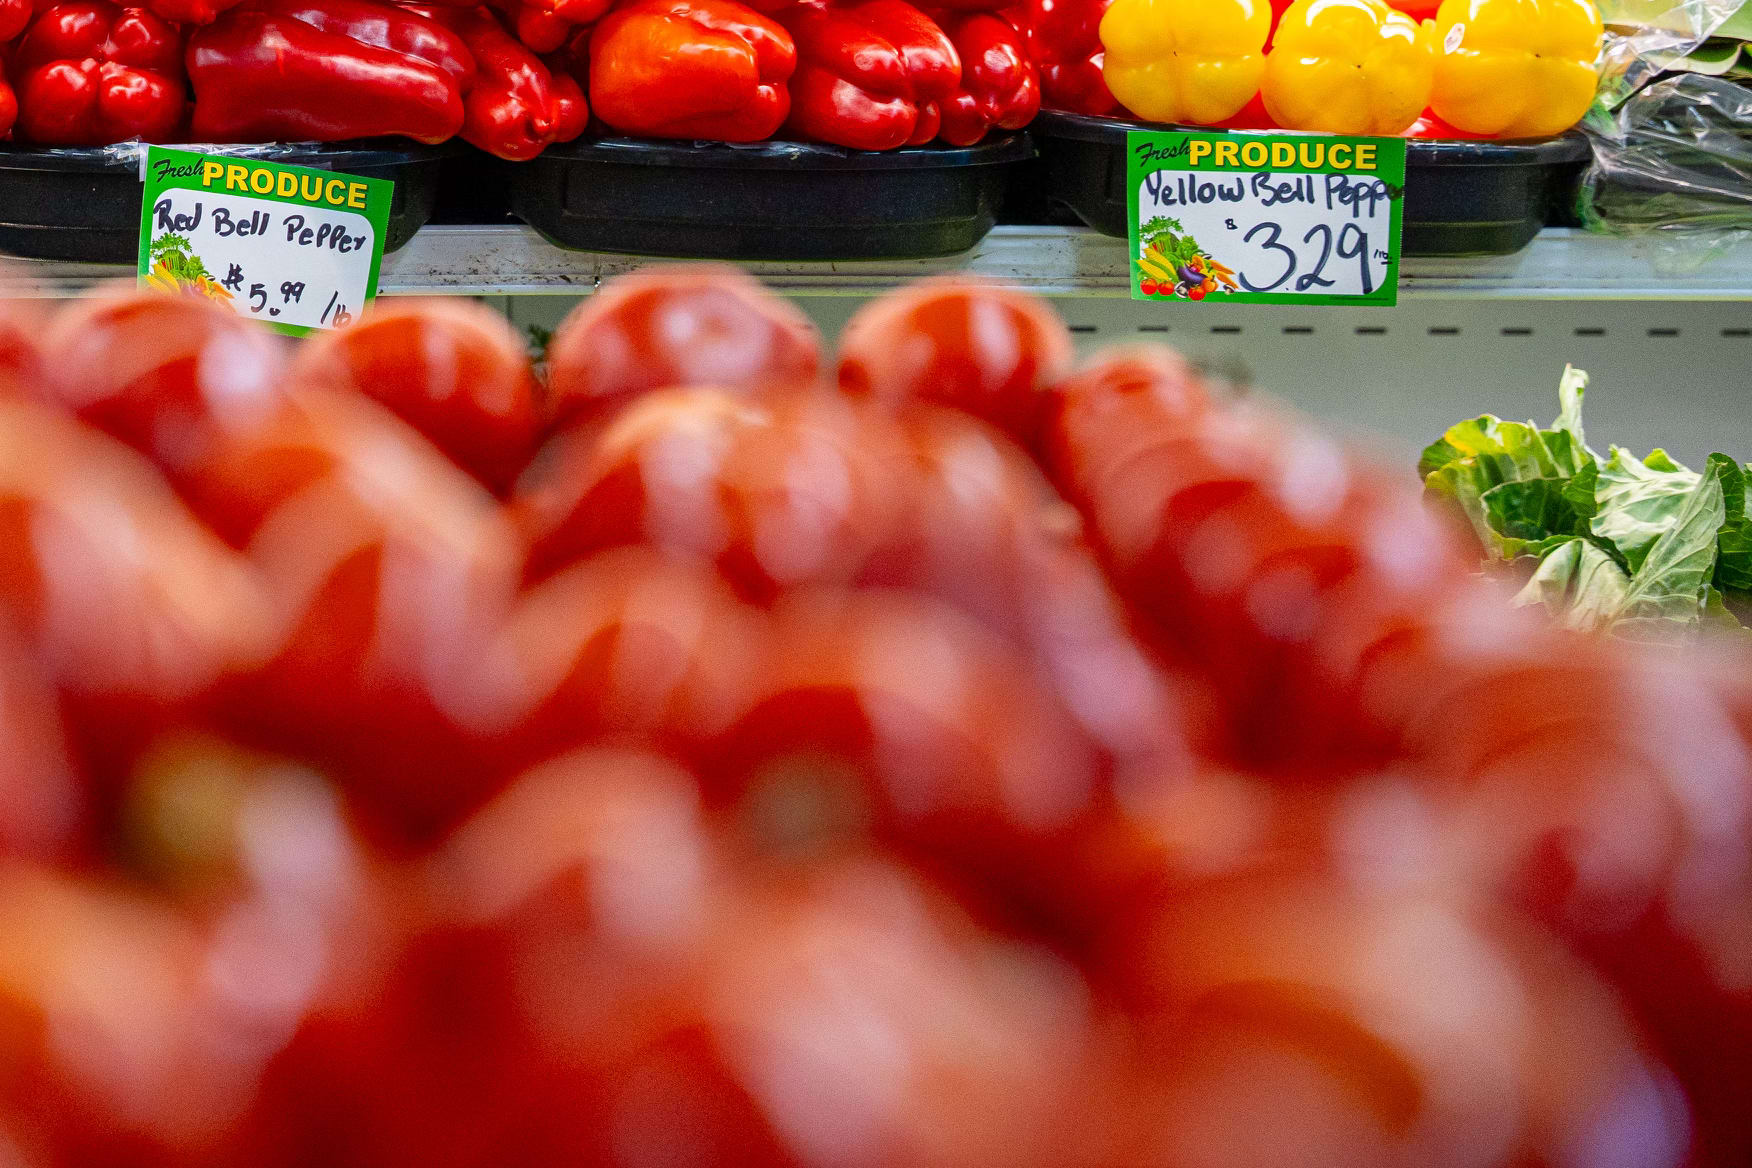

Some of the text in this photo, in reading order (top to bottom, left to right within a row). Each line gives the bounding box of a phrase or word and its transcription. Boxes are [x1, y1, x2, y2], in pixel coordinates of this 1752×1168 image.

[1135, 136, 1377, 170] Fresh PRODUCE
[153, 158, 369, 209] Fresh PRODUCE
[1145, 168, 1246, 206] Yellow
[1251, 171, 1315, 207] Bell
[153, 198, 203, 234] Red
[212, 207, 271, 237] Bell
